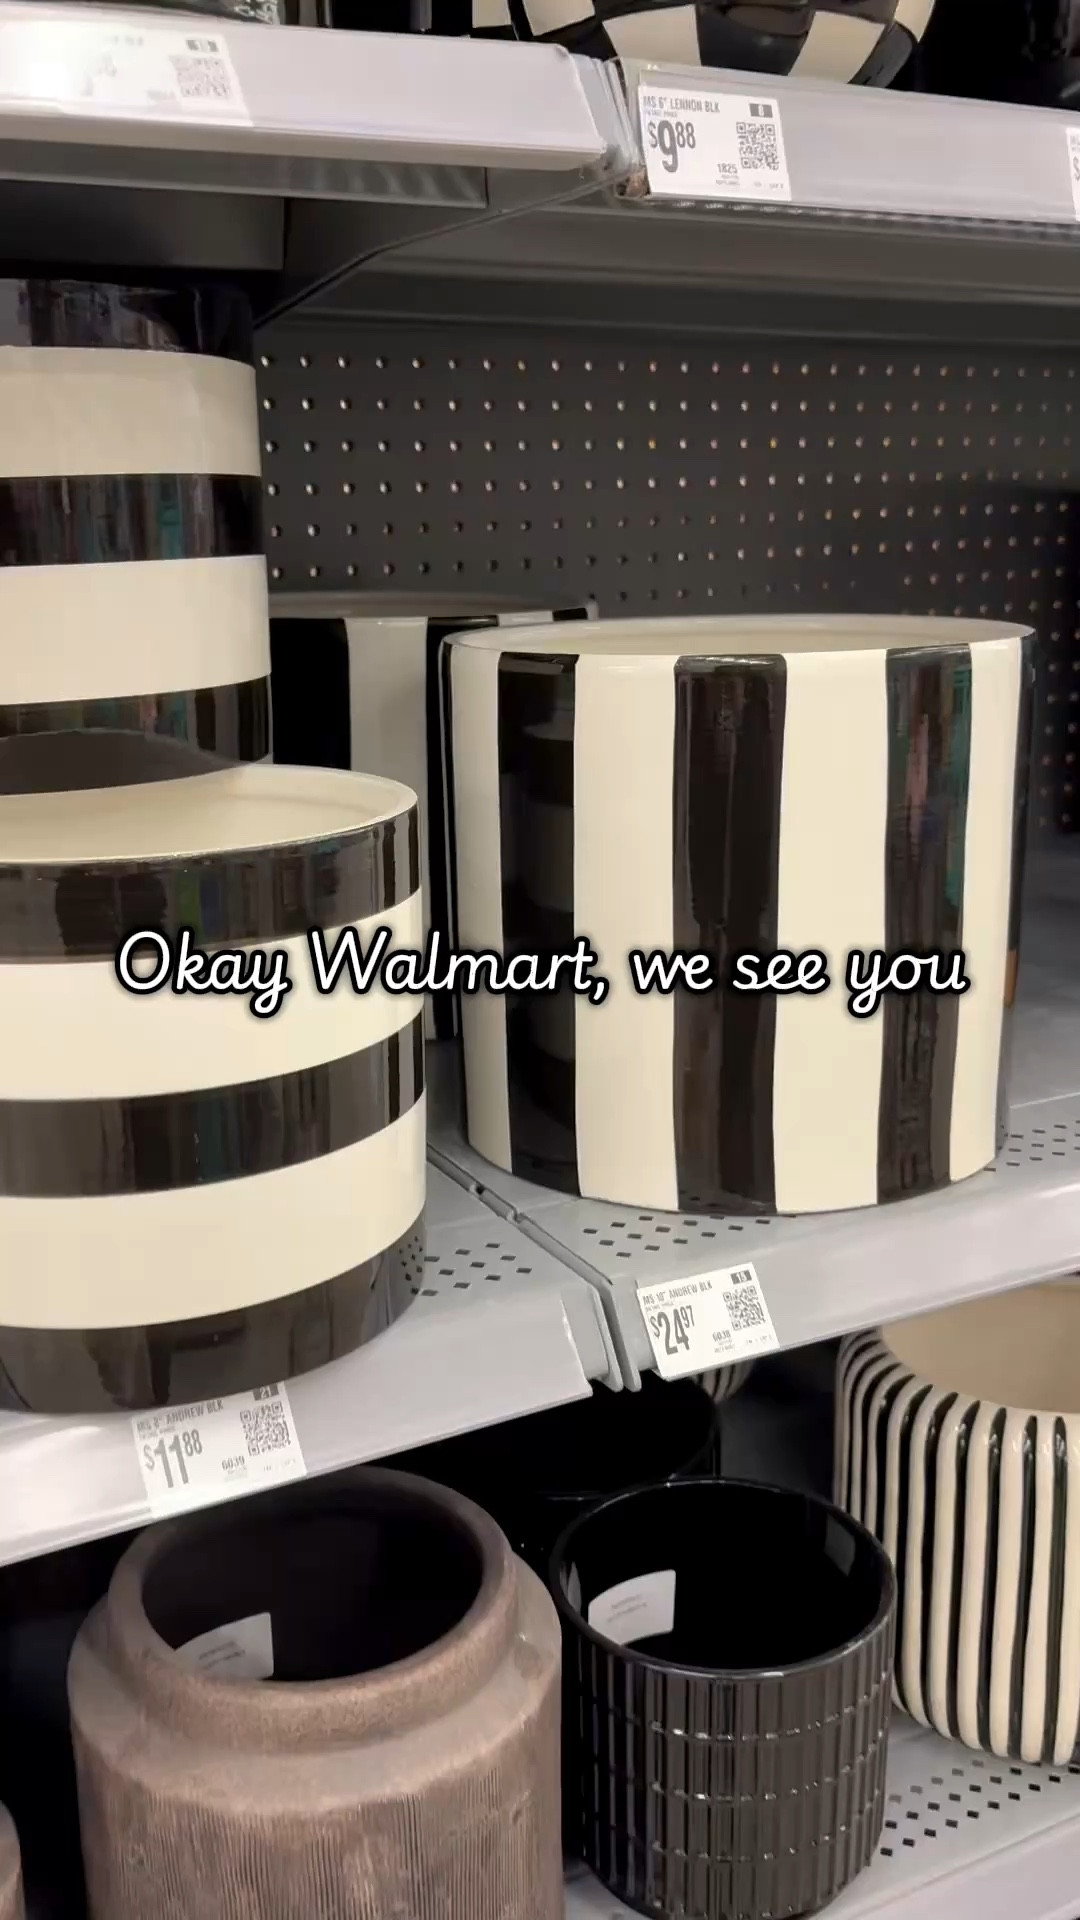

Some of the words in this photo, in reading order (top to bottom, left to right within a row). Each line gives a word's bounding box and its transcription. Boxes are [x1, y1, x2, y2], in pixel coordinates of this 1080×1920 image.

[670, 98, 703, 112] LENNON
[704, 101, 721, 114] BLK
[716, 163, 738, 174] 1825
[668, 1283, 698, 1299] ANDREW
[698, 1279, 713, 1292] BLK
[259, 1385, 272, 1399] 21
[166, 1404, 204, 1425] ANDREW
[205, 1399, 224, 1414] BLK
